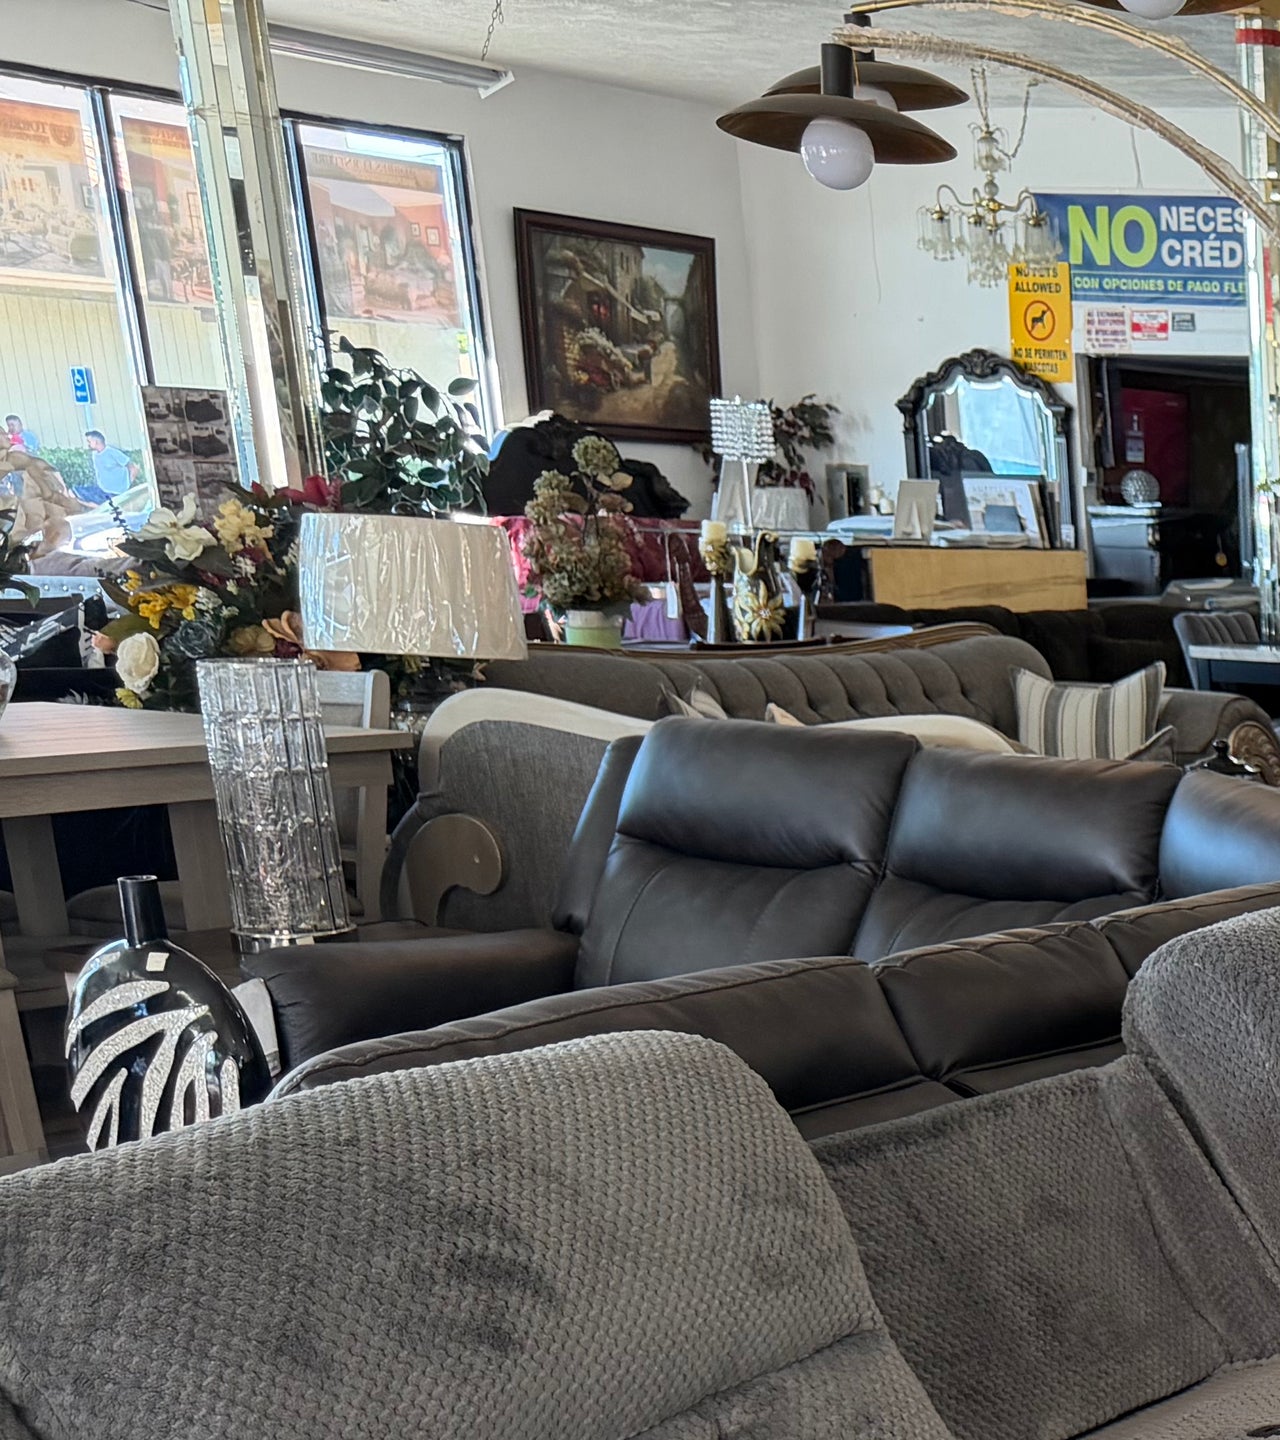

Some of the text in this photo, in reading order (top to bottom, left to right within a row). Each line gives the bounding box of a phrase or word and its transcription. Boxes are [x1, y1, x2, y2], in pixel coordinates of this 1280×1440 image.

[1067, 205, 1158, 268] NO
[1161, 234, 1243, 267] CRÉD
[1015, 282, 1061, 293] ALLOWED
[1074, 277, 1099, 289] CON
[1103, 278, 1164, 292] OPCIONES
[1168, 280, 1182, 291] DE
[1188, 280, 1218, 293] PAGO
[1014, 348, 1023, 357] NO
